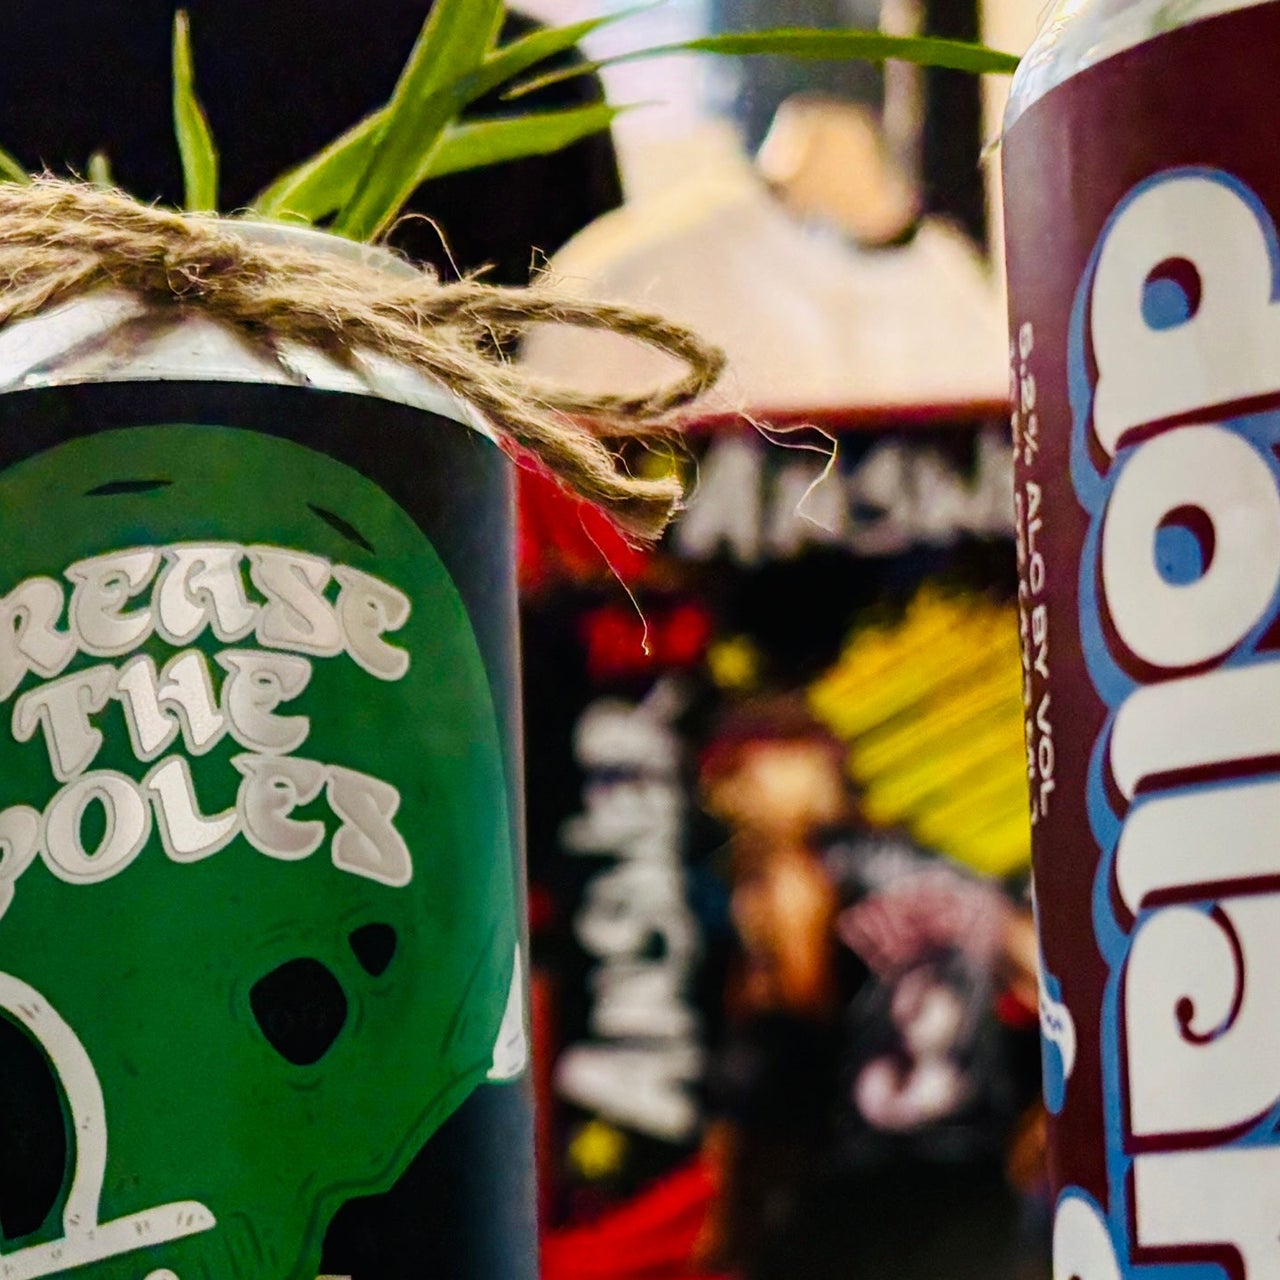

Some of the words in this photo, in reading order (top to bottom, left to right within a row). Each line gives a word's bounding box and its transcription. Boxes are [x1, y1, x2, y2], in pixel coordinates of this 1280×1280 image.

[1027, 481, 1045, 596] ALC
[1031, 604, 1049, 680] BY
[12, 648, 312, 782] THE
[1037, 692, 1056, 817] VOL
